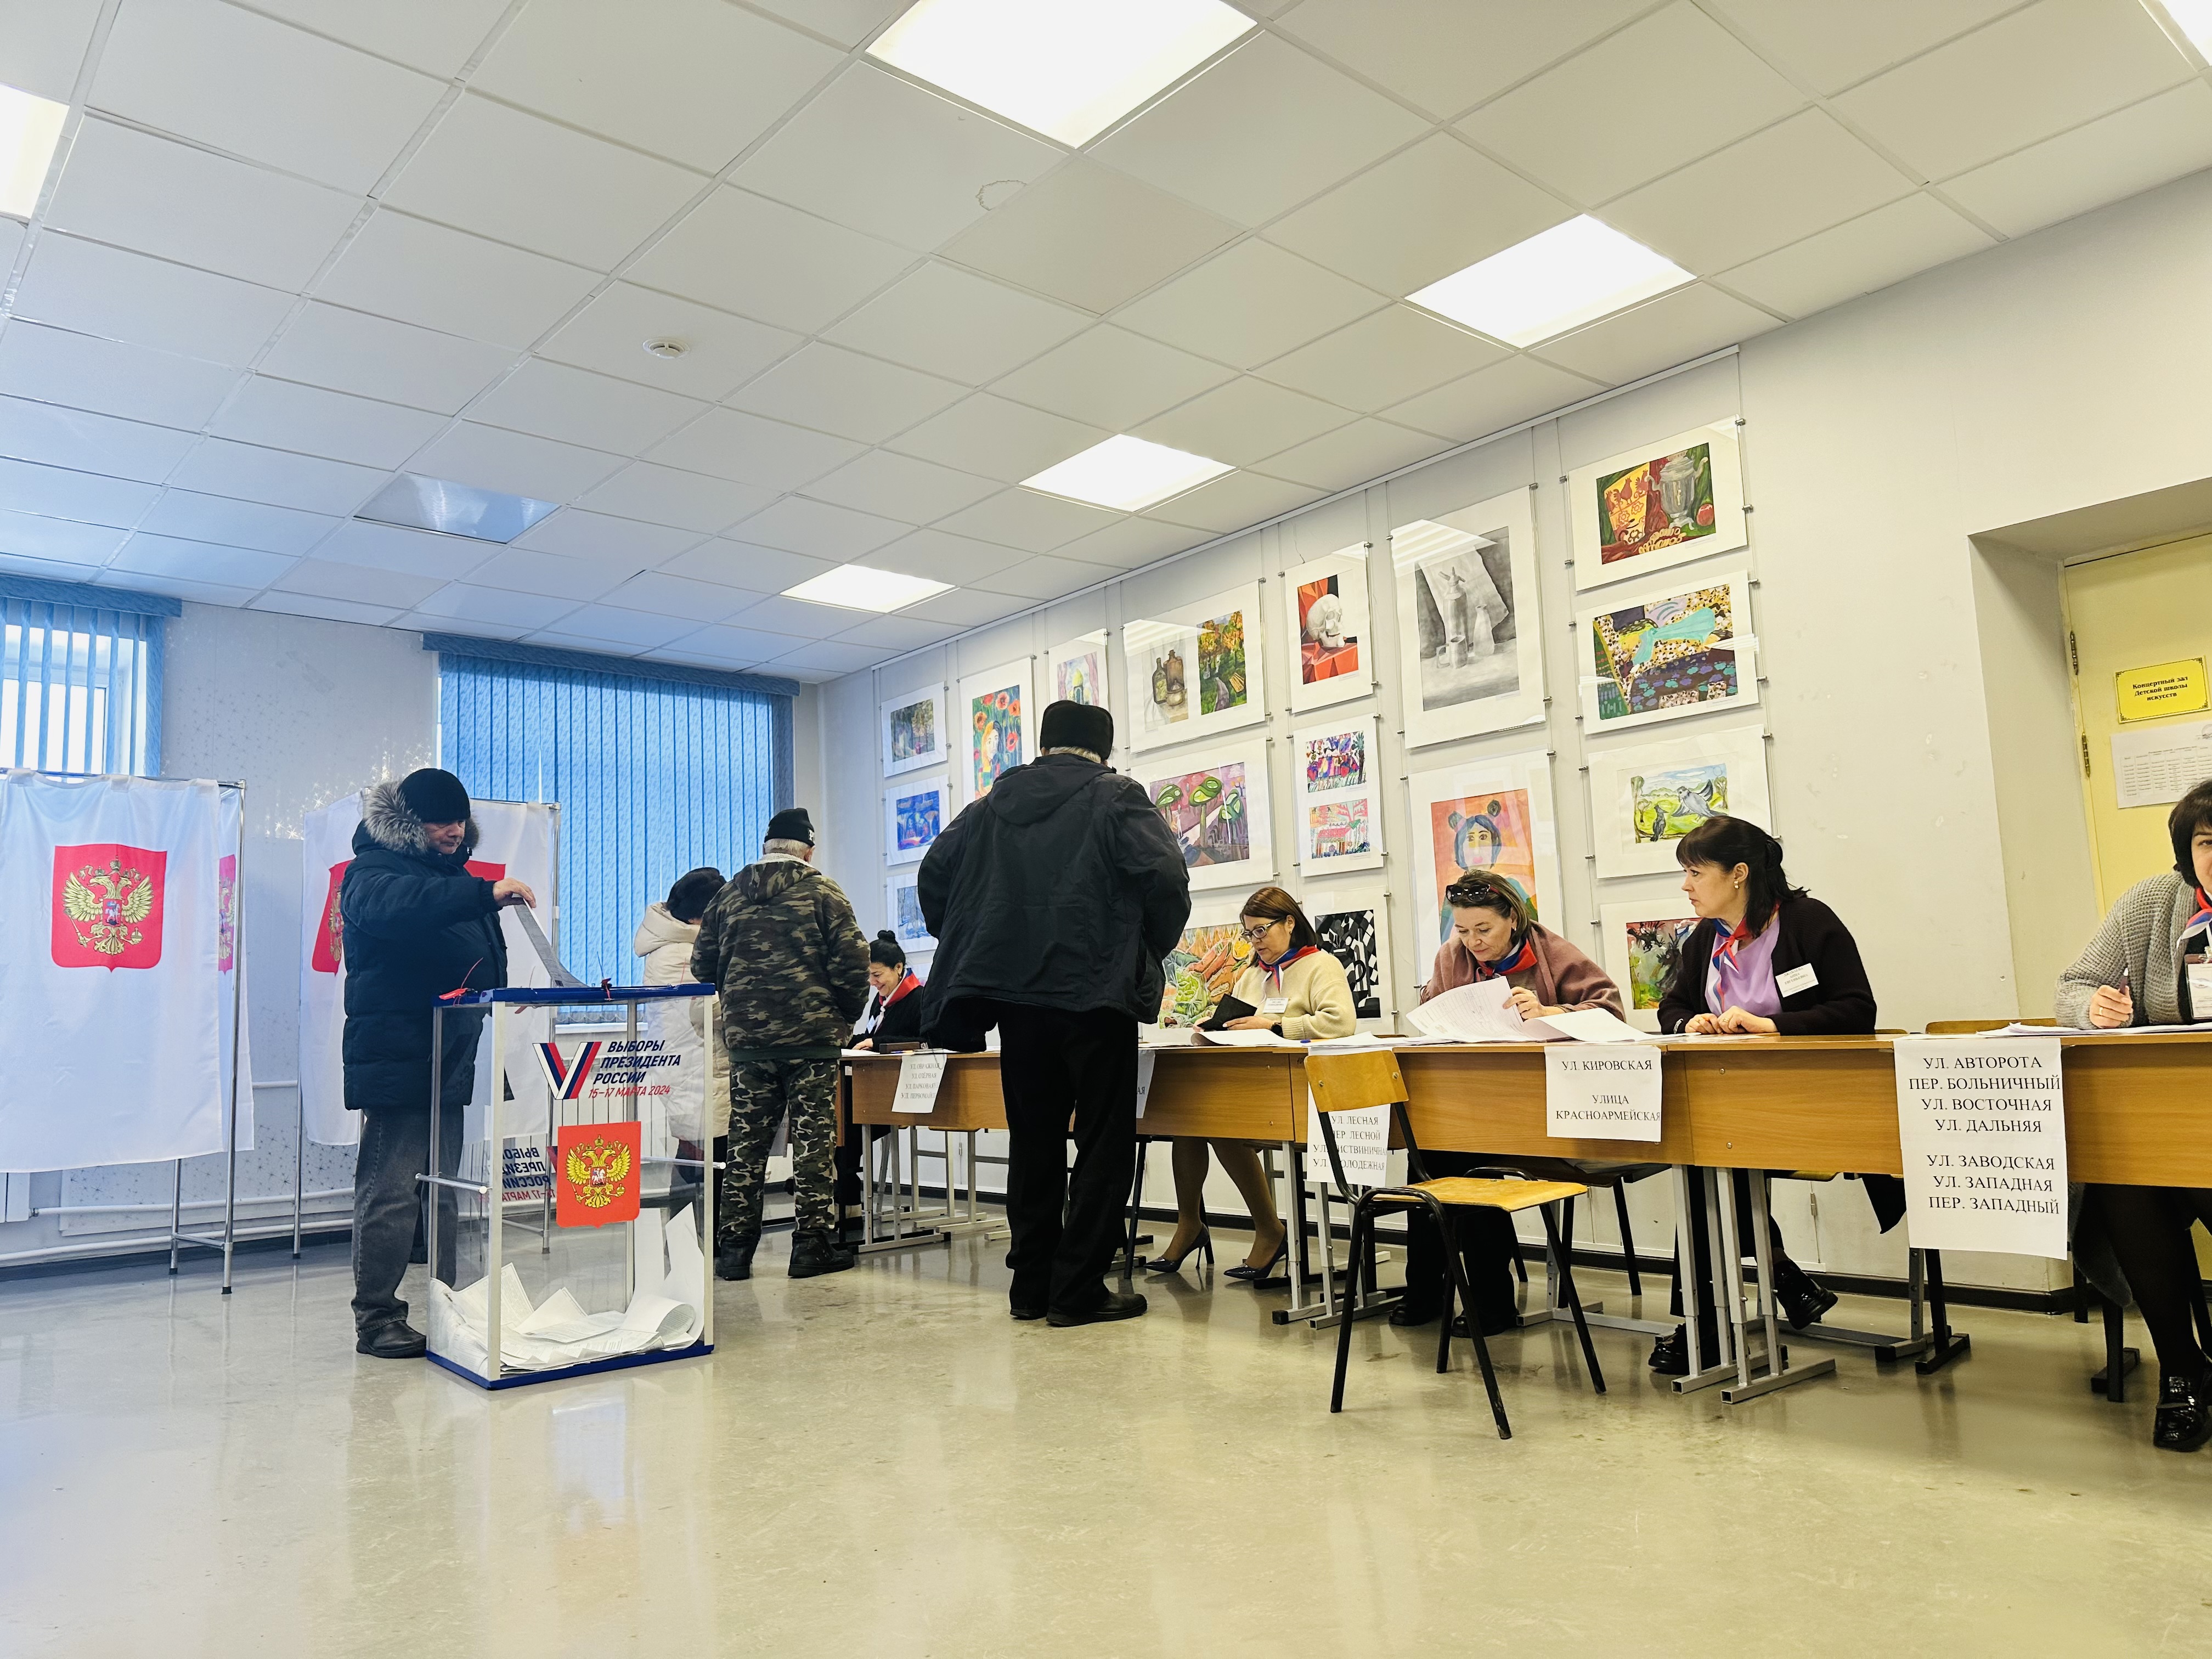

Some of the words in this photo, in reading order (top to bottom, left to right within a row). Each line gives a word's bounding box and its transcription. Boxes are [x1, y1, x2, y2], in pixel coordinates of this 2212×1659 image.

[2132, 678, 2175, 689] Концертный
[2135, 687, 2162, 697] Детской
[607, 1040, 665, 1052] ВЫБОРЫ
[600, 1055, 681, 1069] ПРЕЗИДЕНТА
[1582, 1060, 1652, 1070] КИРОВСКАЯ
[1923, 1058, 1949, 1069] УЛ.
[1954, 1057, 2042, 1069] АВТОРОТА
[593, 1071, 646, 1084] РОССИИ
[1909, 1078, 1943, 1090] ПЕР.
[1948, 1074, 2060, 1090] БОЛЬНИЧНЫЙ
[615, 1086, 647, 1097] МАРТА
[648, 1085, 671, 1096] 2024
[1592, 1095, 1629, 1105] УЛИЦА
[1921, 1099, 1948, 1110] УЛ.
[1953, 1098, 2051, 1110] ВОСТОЧНАЯ
[1346, 1116, 1379, 1125] ЛЕСНАЯ
[1556, 1109, 1660, 1121] КРАСНОАРМЕЙСКАЯ
[1934, 1119, 1961, 1131] УЛ.
[1966, 1120, 2042, 1133] ДАЛЬНЯЯ
[1350, 1130, 1380, 1140] ЛЕСНОЙ
[1341, 1160, 1385, 1170] ОЛОДЕЖНАЯ
[1927, 1155, 1954, 1166] УЛ.
[1959, 1155, 2055, 1170] ЗАВОДСКАЯ
[1933, 1176, 1960, 1188] УЛ.
[1965, 1176, 2053, 1192] ЗАПАДНАЯ
[1929, 1197, 1965, 1209] ПЕР.
[1970, 1198, 2059, 1214] ЗАПАДНЫЙ
